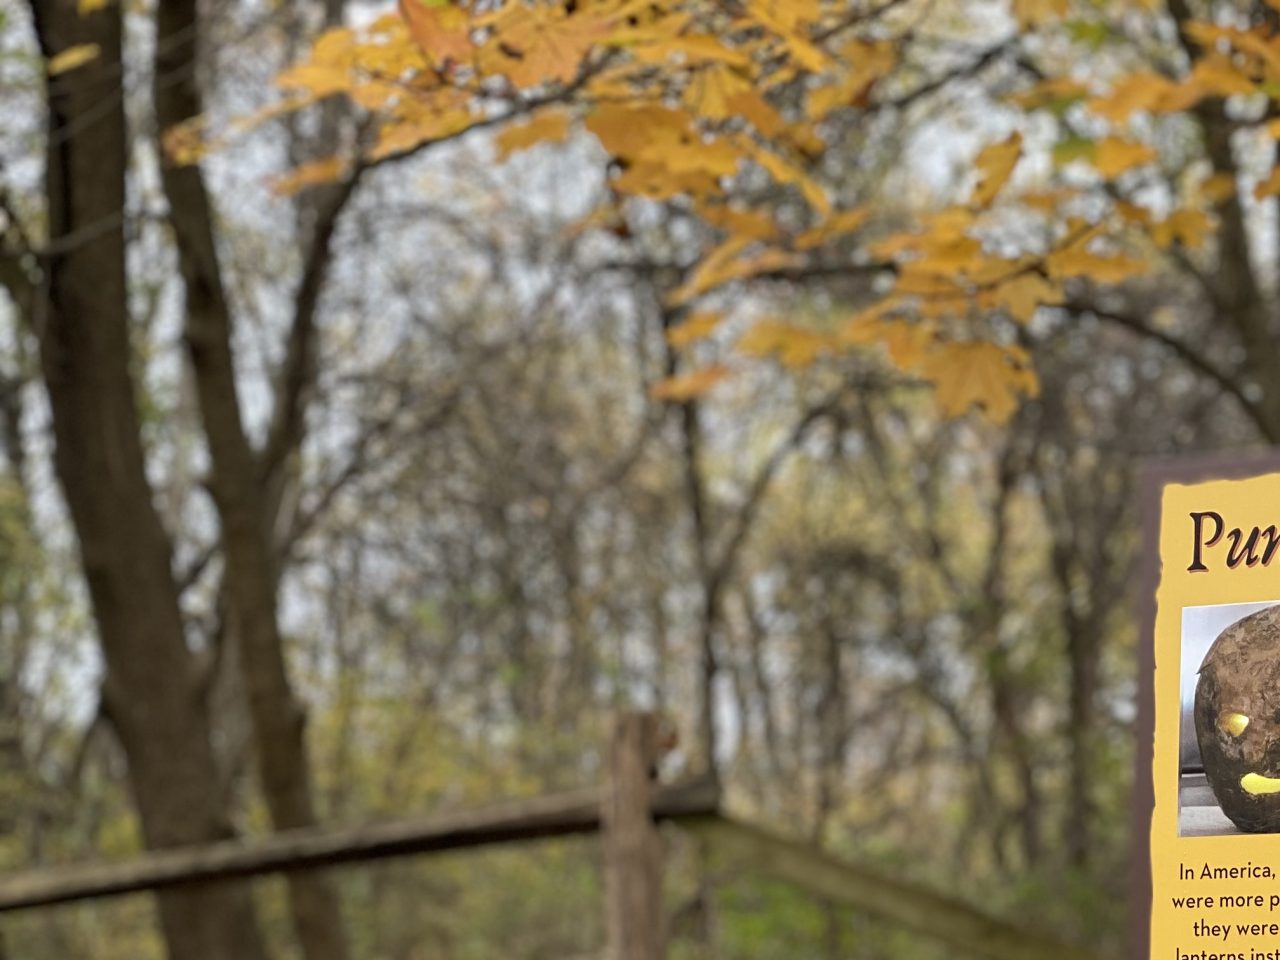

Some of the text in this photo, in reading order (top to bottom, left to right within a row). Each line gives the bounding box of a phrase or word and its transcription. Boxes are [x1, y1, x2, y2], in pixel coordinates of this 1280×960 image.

[1179, 862, 1195, 881] In
[1199, 861, 1276, 880] America,
[1171, 896, 1215, 909] were
[1219, 895, 1265, 908] more
[1193, 918, 1232, 942] they
[1236, 923, 1280, 936] were
